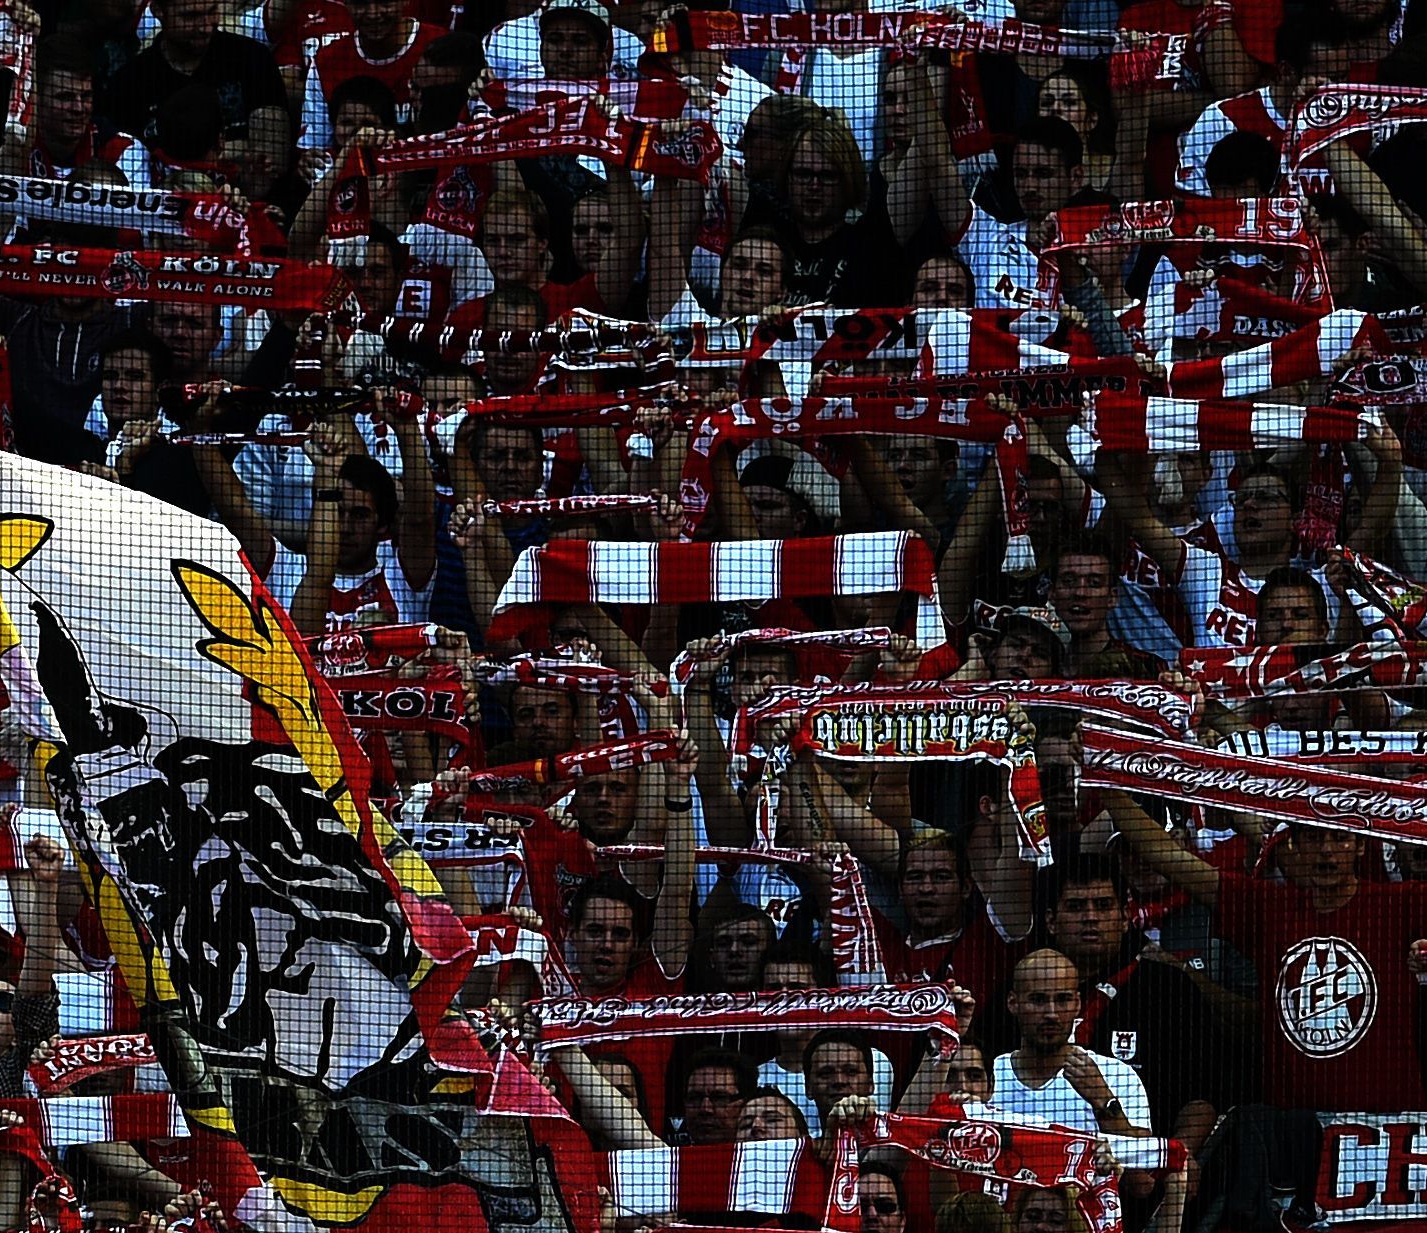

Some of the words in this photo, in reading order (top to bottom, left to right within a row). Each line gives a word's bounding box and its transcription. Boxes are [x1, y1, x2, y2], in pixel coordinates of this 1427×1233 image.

[32, 248, 79, 265] FC
[159, 253, 281, 280] KÖLN
[37, 272, 98, 286] NEVER
[156, 279, 205, 294] WALK
[212, 282, 274, 298] ALONE
[336, 685, 467, 723] KÖL
